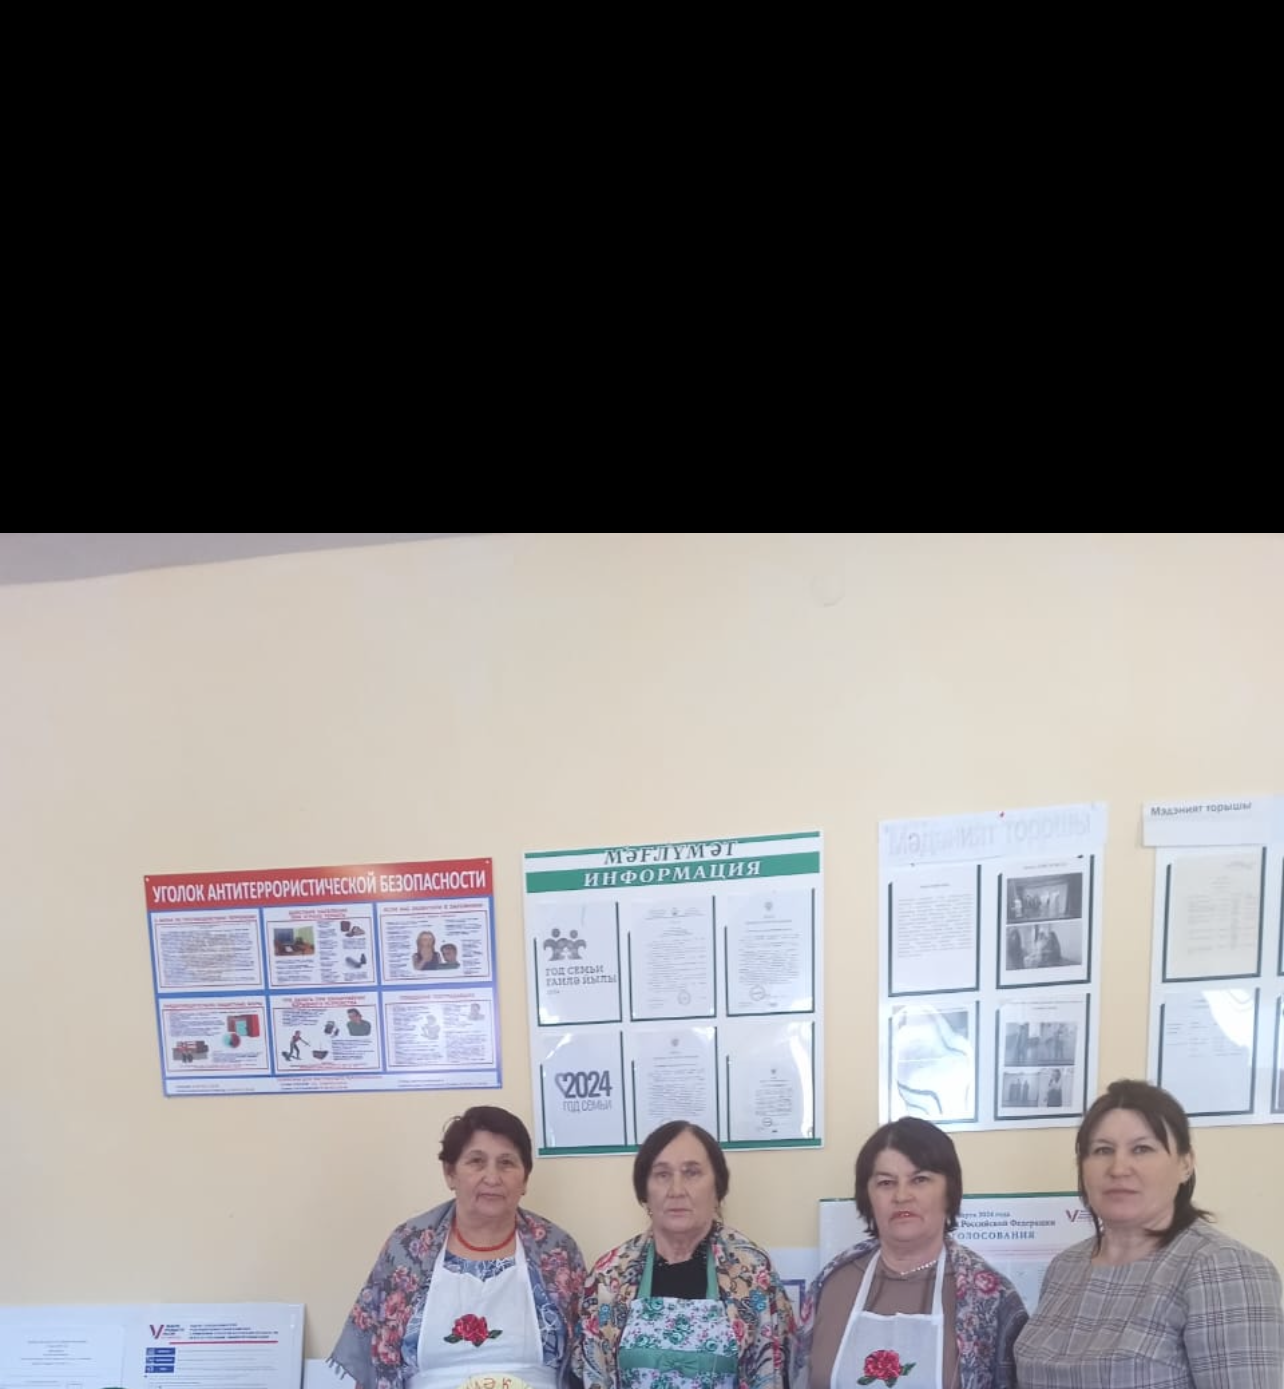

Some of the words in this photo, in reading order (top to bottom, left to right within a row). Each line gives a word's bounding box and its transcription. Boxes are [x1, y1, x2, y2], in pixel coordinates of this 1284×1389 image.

[583, 860, 761, 887] ИНФОРМАЦИЯ
[152, 883, 205, 903] УГОЛОК
[207, 871, 377, 901] АНТИТЕРРОРИСТИЧЕСКОЙ
[380, 869, 487, 893] БЕЗОПАСНОСТИ
[545, 967, 565, 977] ГОД
[567, 965, 604, 976] СЕМЬИ
[562, 1070, 613, 1099] 2024
[562, 1100, 580, 1114] ГОД
[581, 1099, 612, 1112] СЕМЬИ
[957, 1231, 1035, 1240] ОЛОСОВАНИЯ
